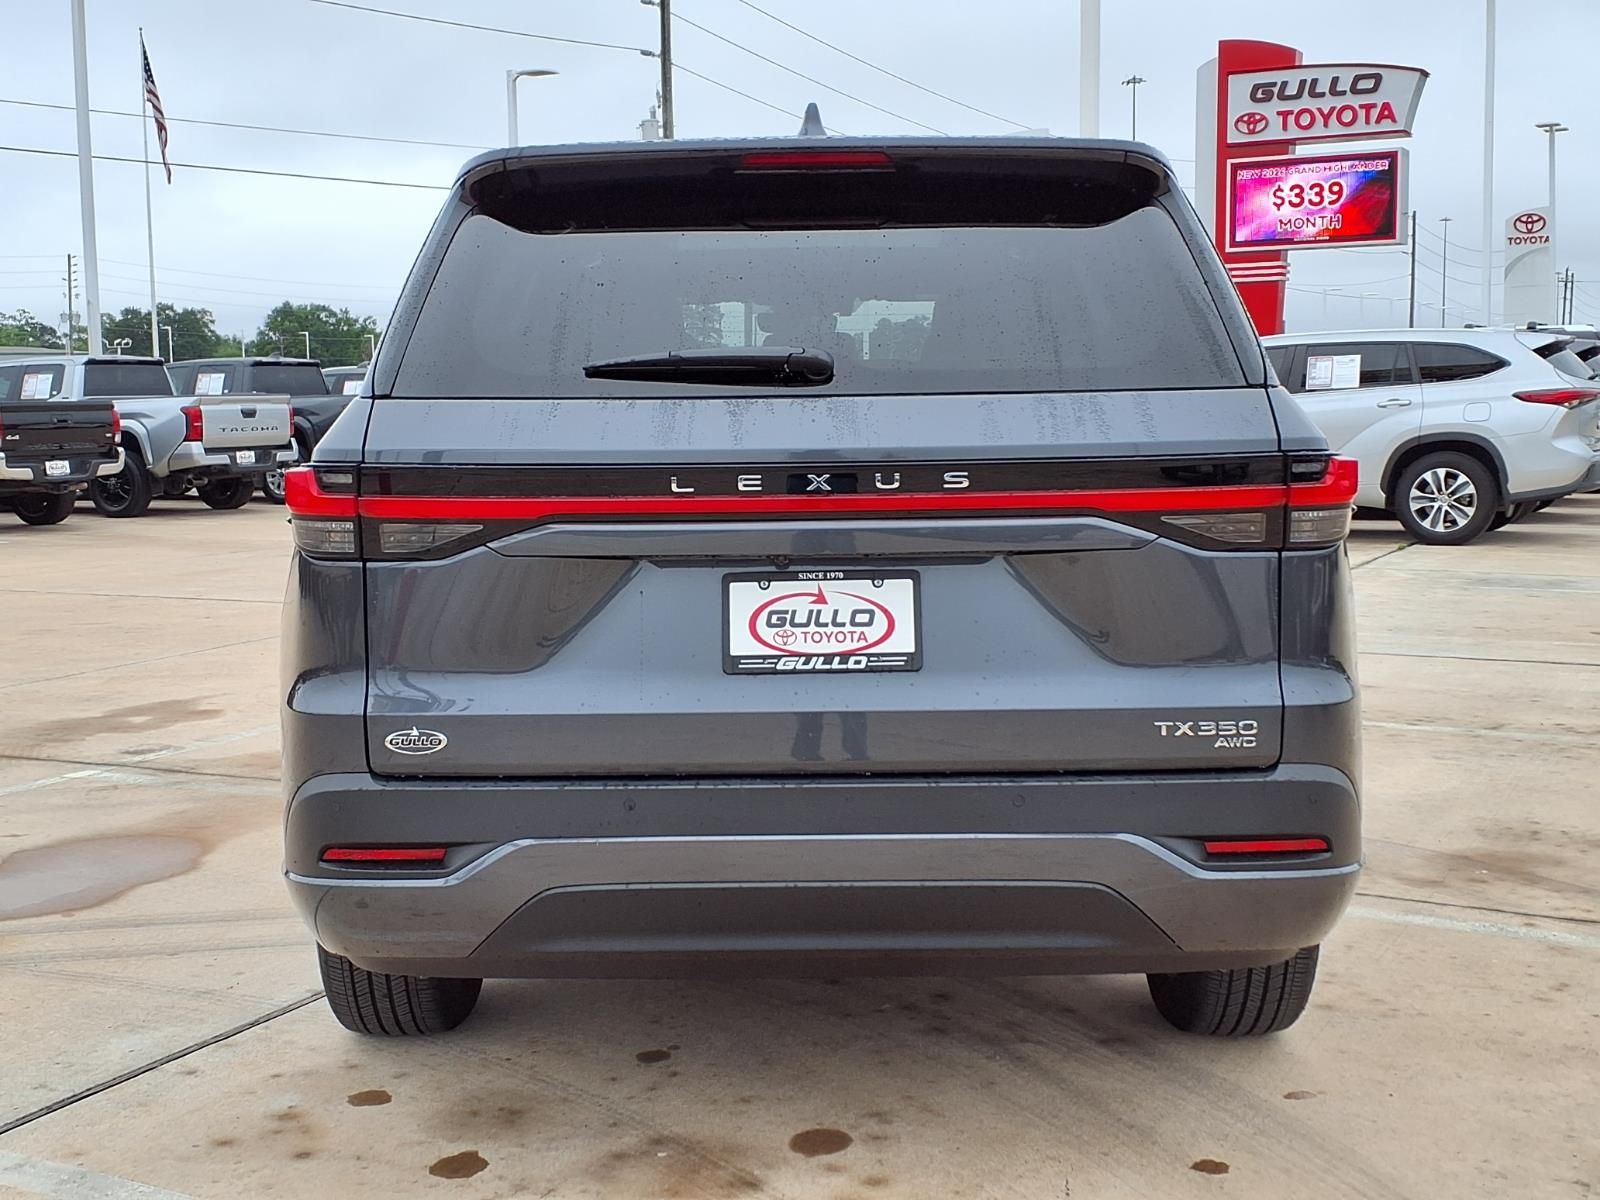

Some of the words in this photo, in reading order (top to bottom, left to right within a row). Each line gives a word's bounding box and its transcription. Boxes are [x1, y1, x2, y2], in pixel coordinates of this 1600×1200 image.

[1250, 73, 1383, 103] GULLO
[1276, 102, 1397, 131] TOYOTA
[1237, 169, 1261, 179] NEW
[1288, 165, 1321, 176] GRAND
[1323, 160, 1388, 173] HIGHLANDER
[1272, 180, 1344, 211] $339
[1278, 214, 1342, 231] MONTH
[1507, 235, 1550, 246] TOYOTA
[219, 425, 279, 433] TACOMA
[670, 472, 969, 493] LEXUS
[798, 571, 825, 580] SINCE
[826, 571, 844, 580] 1970
[765, 608, 876, 628] GULLO
[801, 630, 869, 645] TOYOTA
[775, 655, 868, 670] GULLO
[388, 736, 443, 747] GULLO
[1213, 736, 1257, 748] AWD
